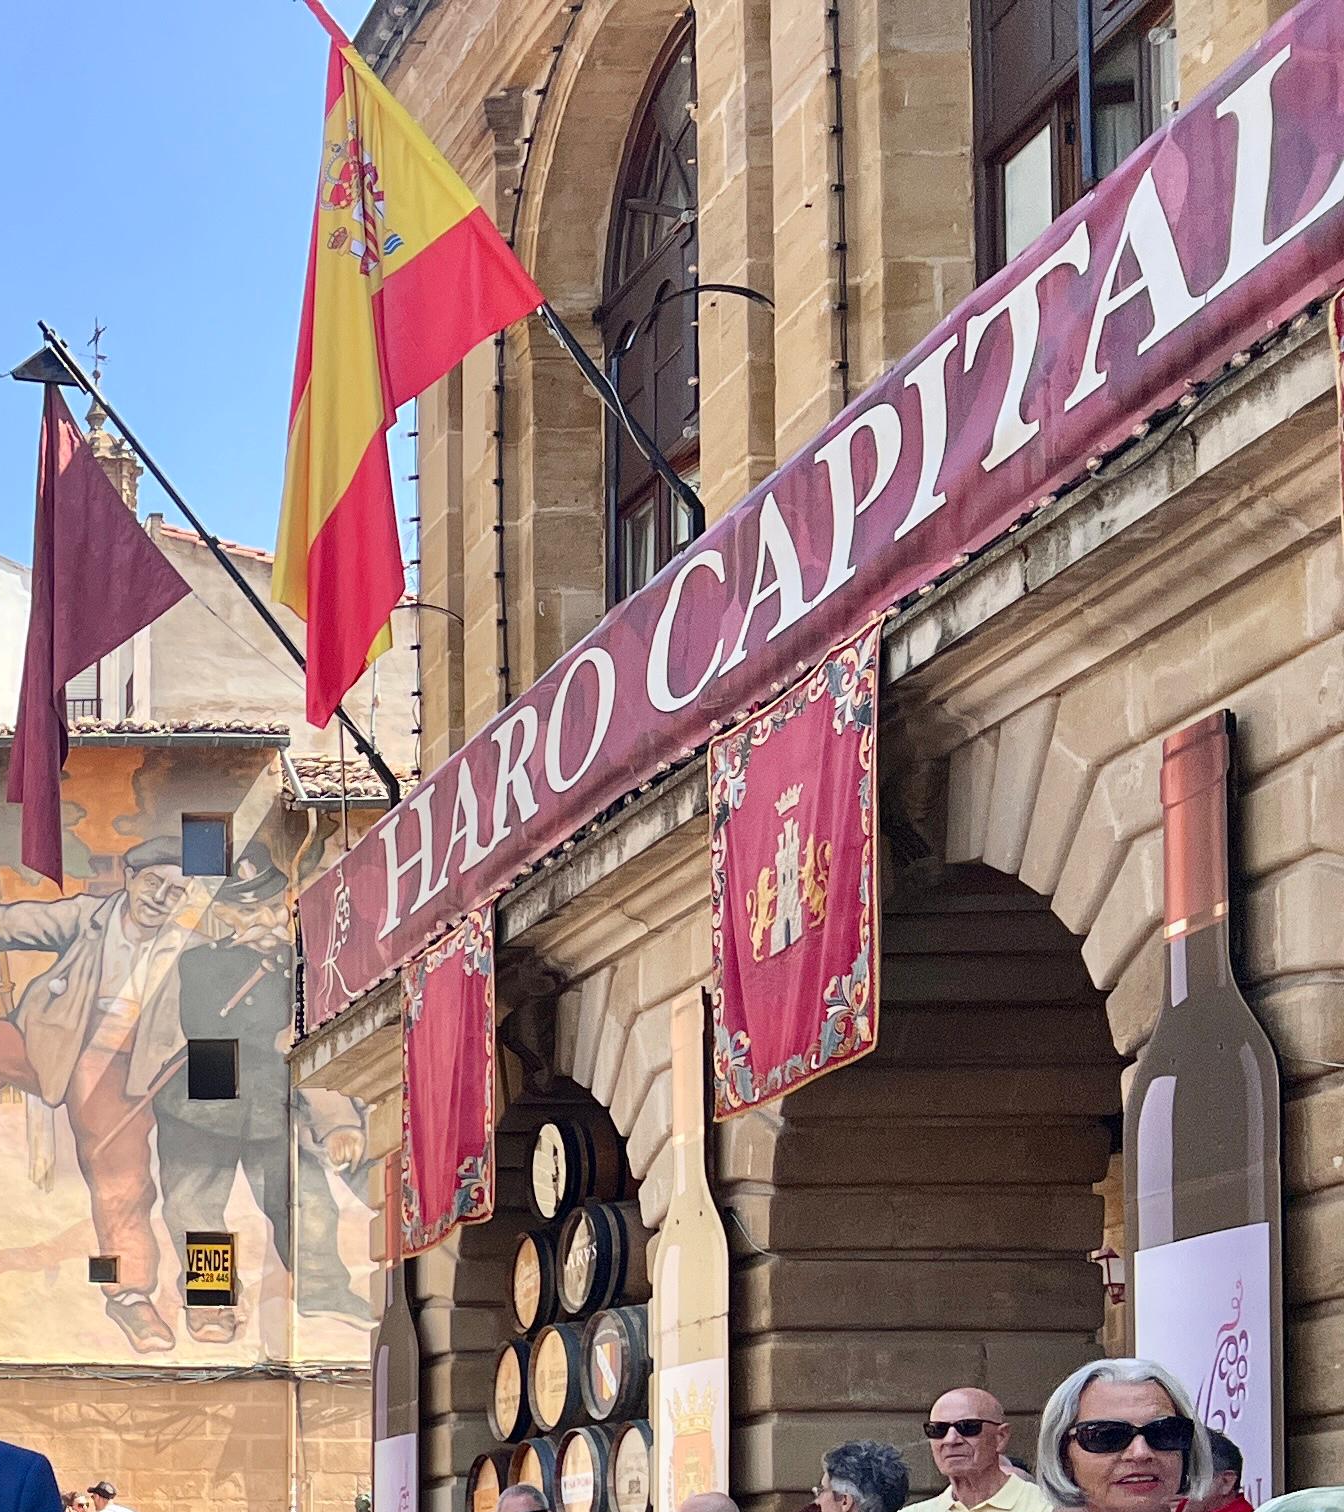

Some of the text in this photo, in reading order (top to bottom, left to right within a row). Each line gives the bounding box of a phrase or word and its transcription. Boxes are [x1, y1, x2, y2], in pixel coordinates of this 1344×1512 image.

[378, 43, 1344, 941] HARO CAPITAL
[187, 1249, 229, 1272] VENDE
